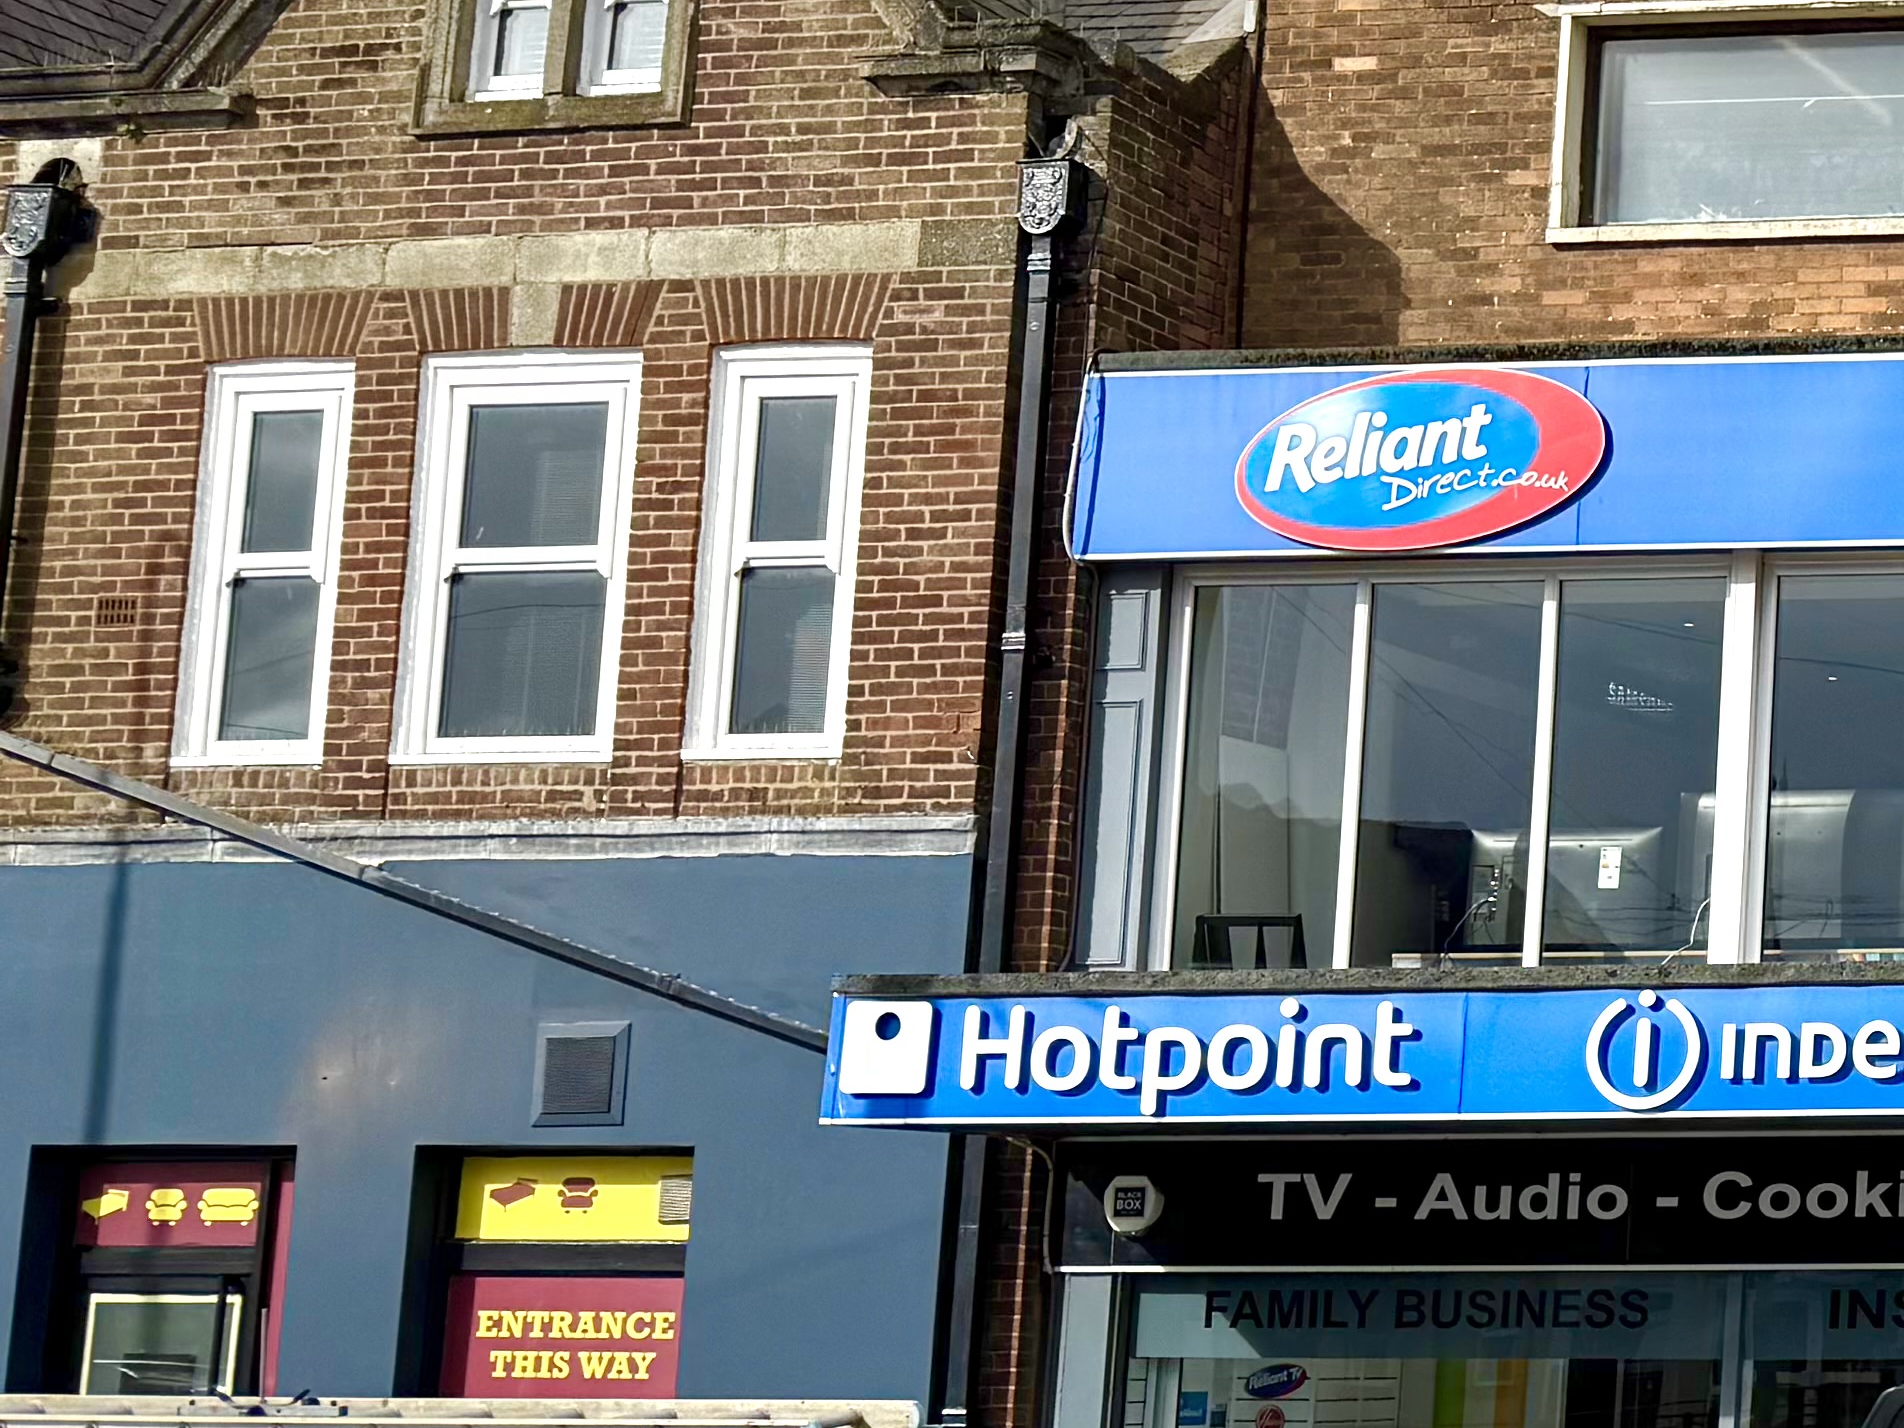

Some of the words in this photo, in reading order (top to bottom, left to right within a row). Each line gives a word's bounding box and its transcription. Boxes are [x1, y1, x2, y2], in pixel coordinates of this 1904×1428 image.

[1264, 402, 1490, 495] Reliant
[1381, 464, 1571, 512] Direct.co.uk
[960, 995, 1414, 1116] Hotpoint
[1116, 1199, 1142, 1210] BOX
[1257, 1173, 1350, 1220] TV
[1414, 1171, 1629, 1222] Audio
[476, 1310, 675, 1341] ENTRANCE
[1202, 1289, 1378, 1329] FAMILY
[1394, 1288, 1649, 1331] BUSINESS
[490, 1350, 570, 1380] THIS
[578, 1350, 656, 1381] WAY
